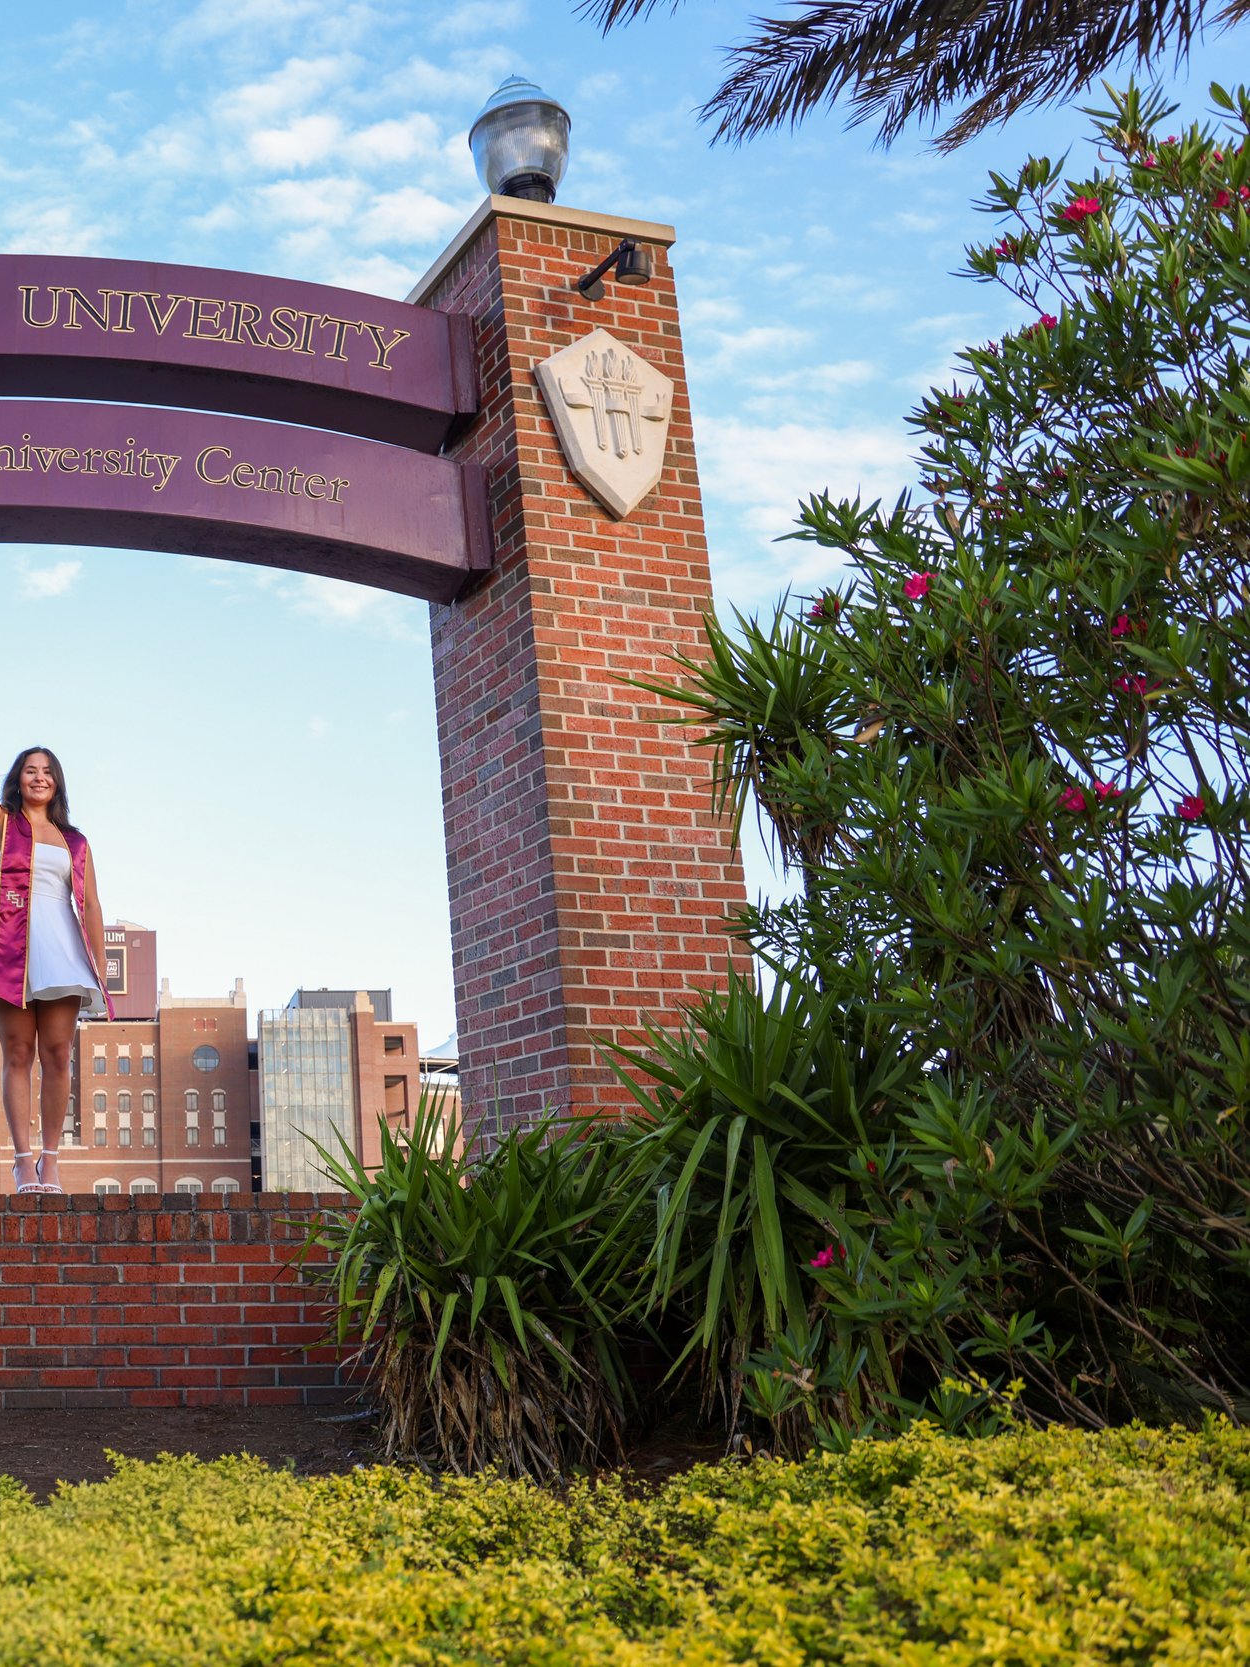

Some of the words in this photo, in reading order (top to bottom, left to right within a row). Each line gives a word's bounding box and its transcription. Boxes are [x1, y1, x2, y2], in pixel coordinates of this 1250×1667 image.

[18, 285, 411, 371] UNIVERSITY
[195, 446, 351, 504] Center
[6, 890, 24, 908] FSU
